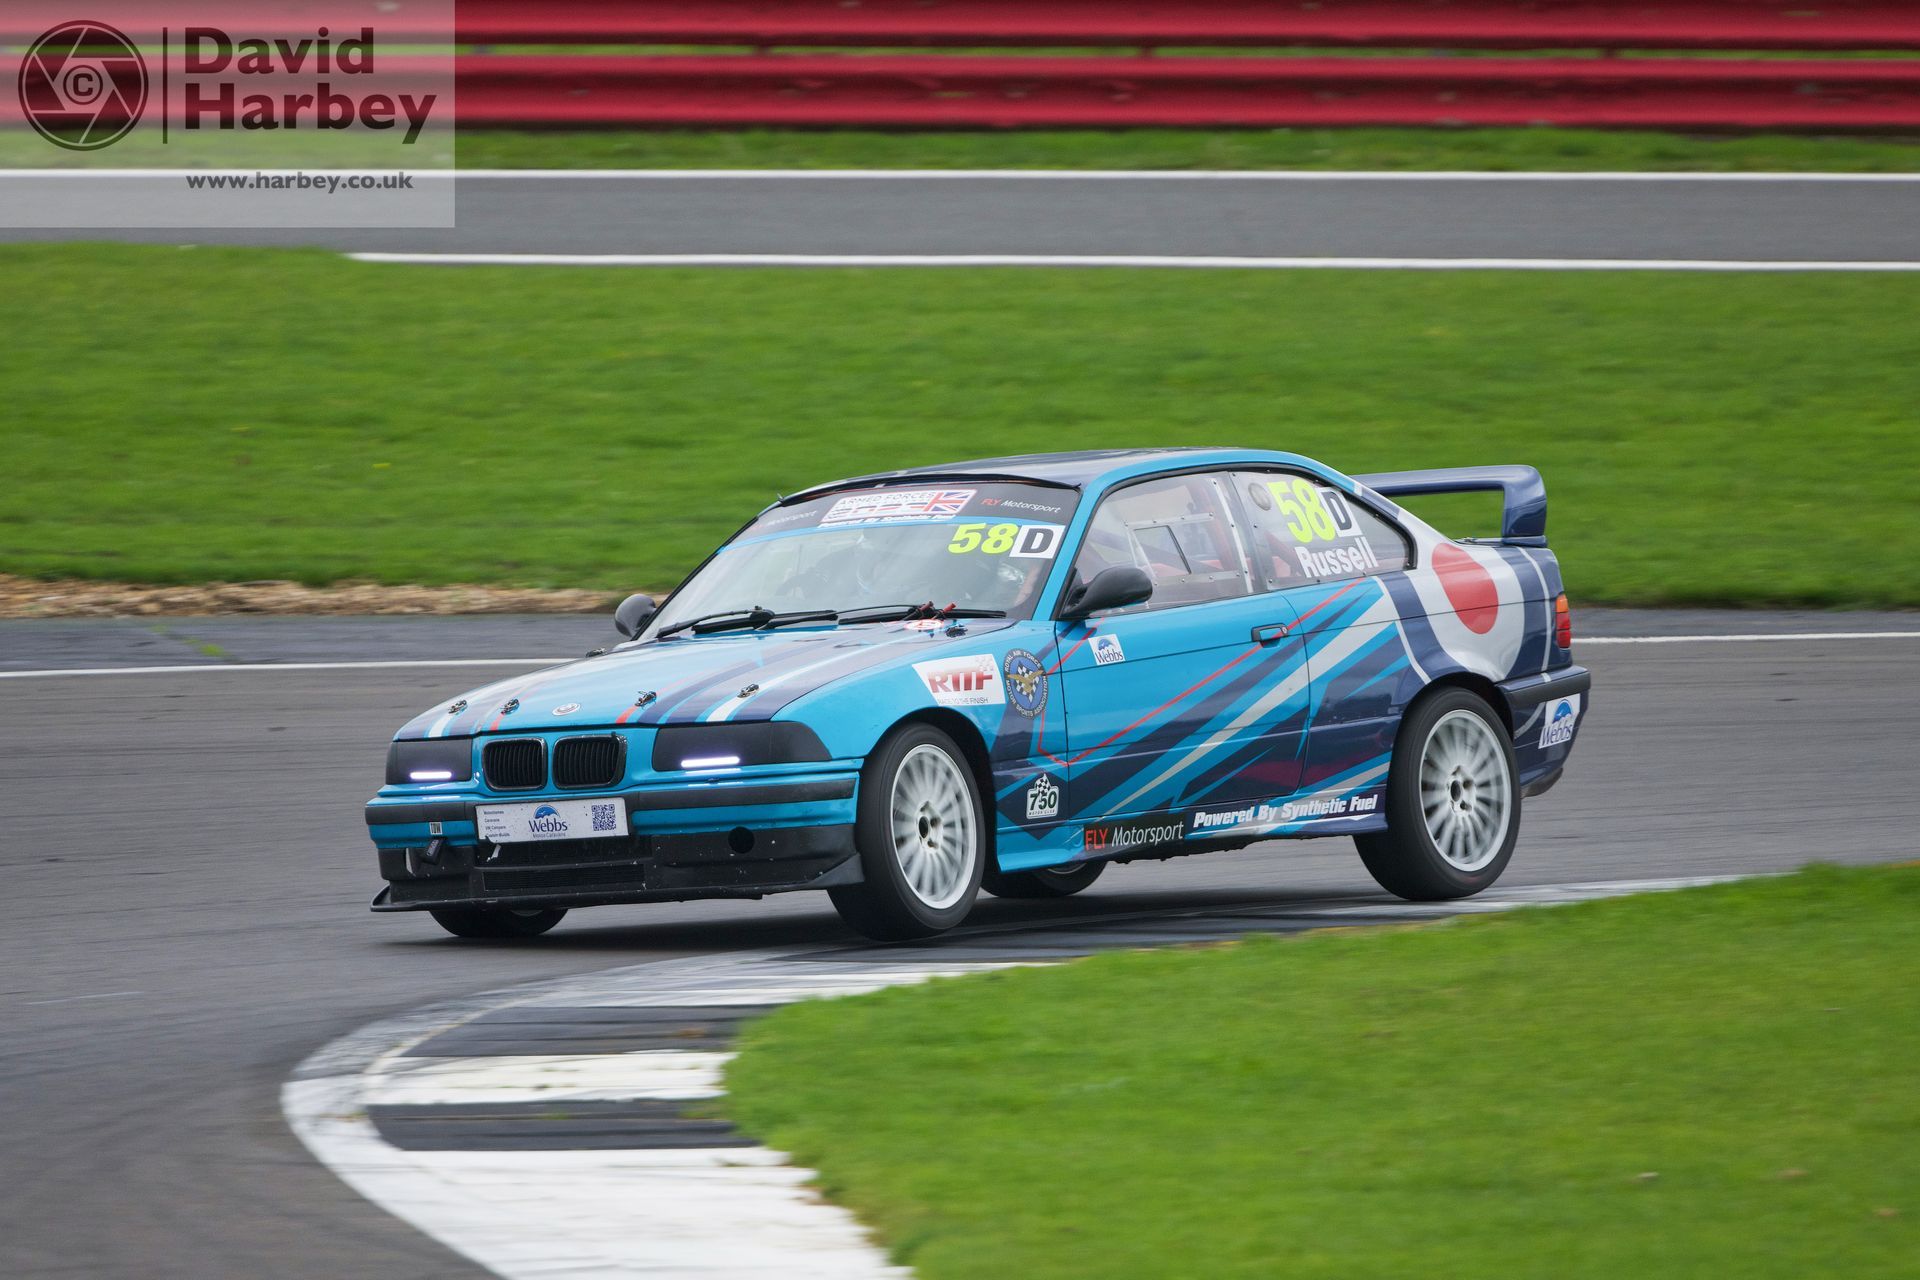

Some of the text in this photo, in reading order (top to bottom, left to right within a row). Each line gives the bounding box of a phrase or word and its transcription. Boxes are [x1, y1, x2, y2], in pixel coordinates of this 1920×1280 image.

[886, 492, 935, 500] FORCES
[981, 498, 1061, 514] FLY Motorsport
[1266, 479, 1352, 543] 58 D
[948, 523, 1054, 554] 58 D
[1294, 536, 1379, 578] Russell
[1095, 649, 1124, 664] Webbs
[1542, 719, 1573, 746] Webbs
[1029, 790, 1058, 811] 750
[1193, 794, 1378, 828] Powered By Synthetic Fuel
[528, 818, 568, 833] Webbs
[1085, 821, 1184, 850] FLY Motorsport
